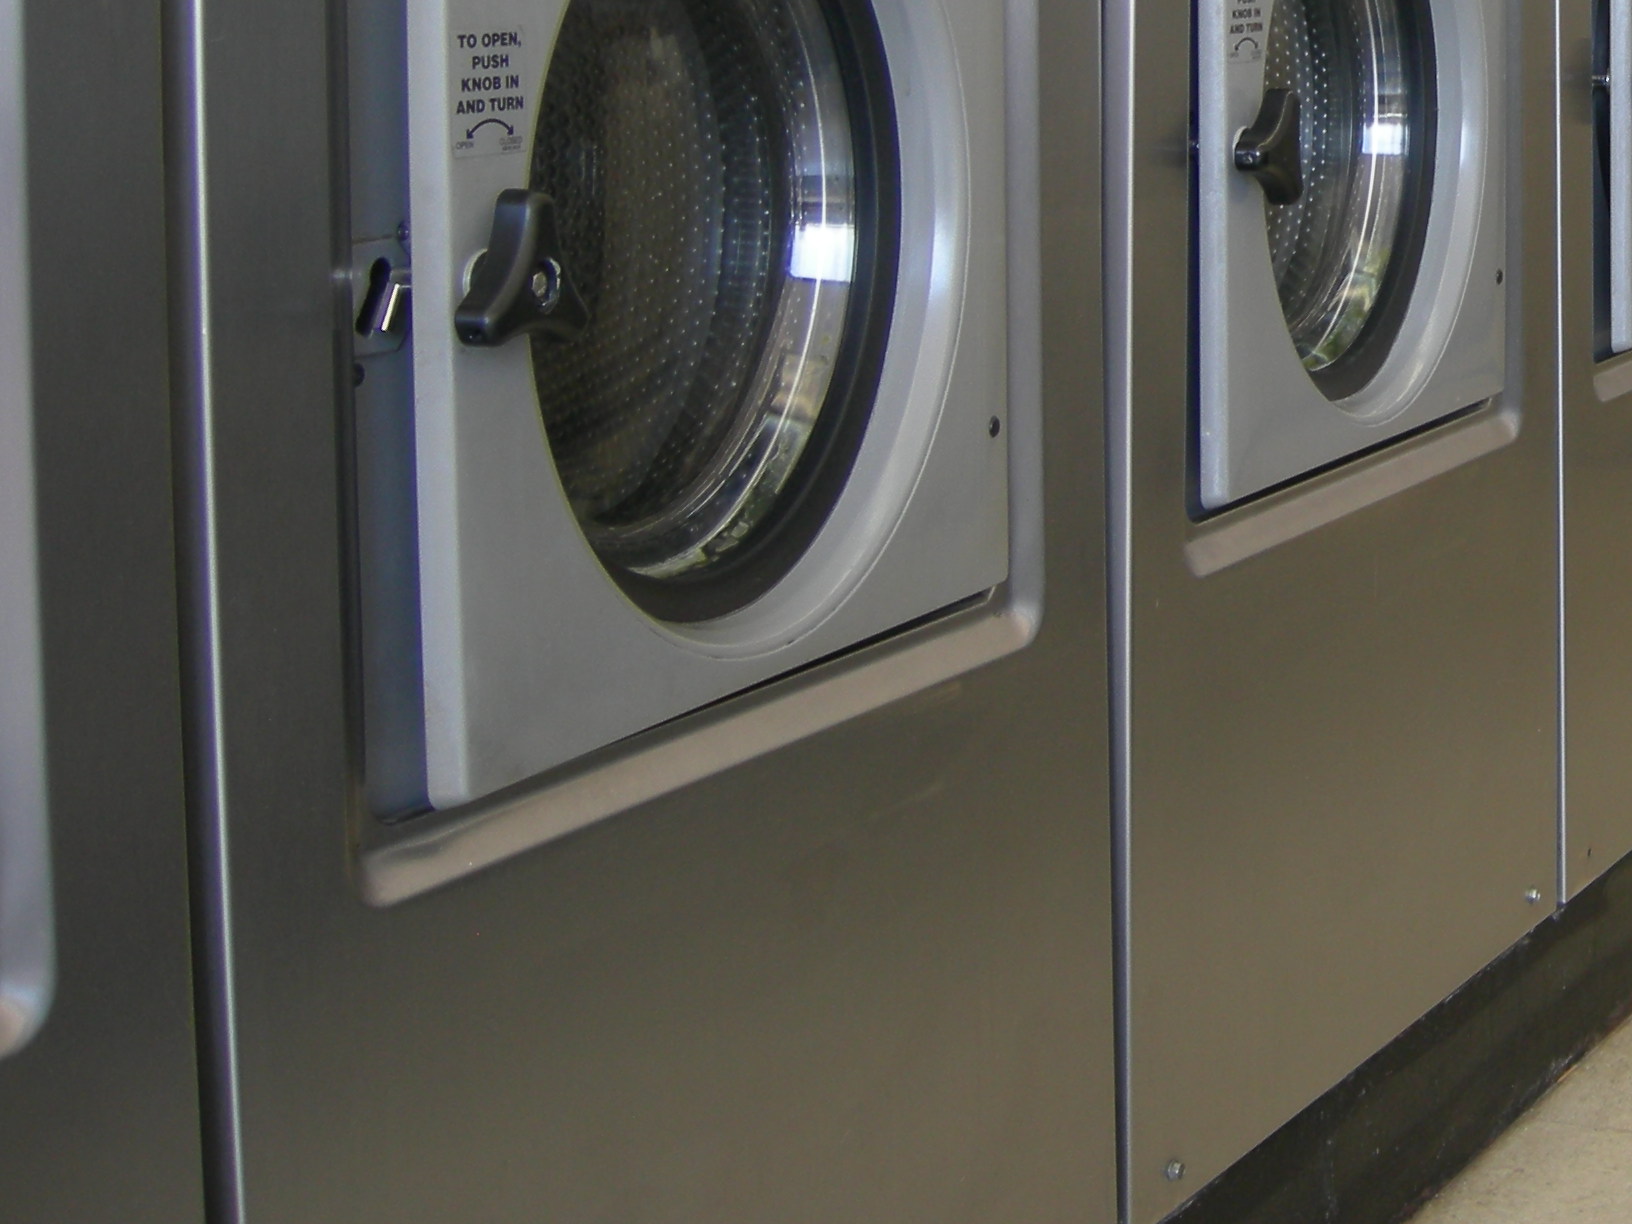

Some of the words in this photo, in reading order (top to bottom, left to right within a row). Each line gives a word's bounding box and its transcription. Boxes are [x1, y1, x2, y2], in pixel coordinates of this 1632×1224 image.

[457, 35, 477, 48] TO
[472, 54, 509, 69] PUSH
[461, 77, 501, 92] KNOB
[505, 75, 519, 88] IN
[456, 99, 485, 114] AND
[489, 96, 524, 112] TURN
